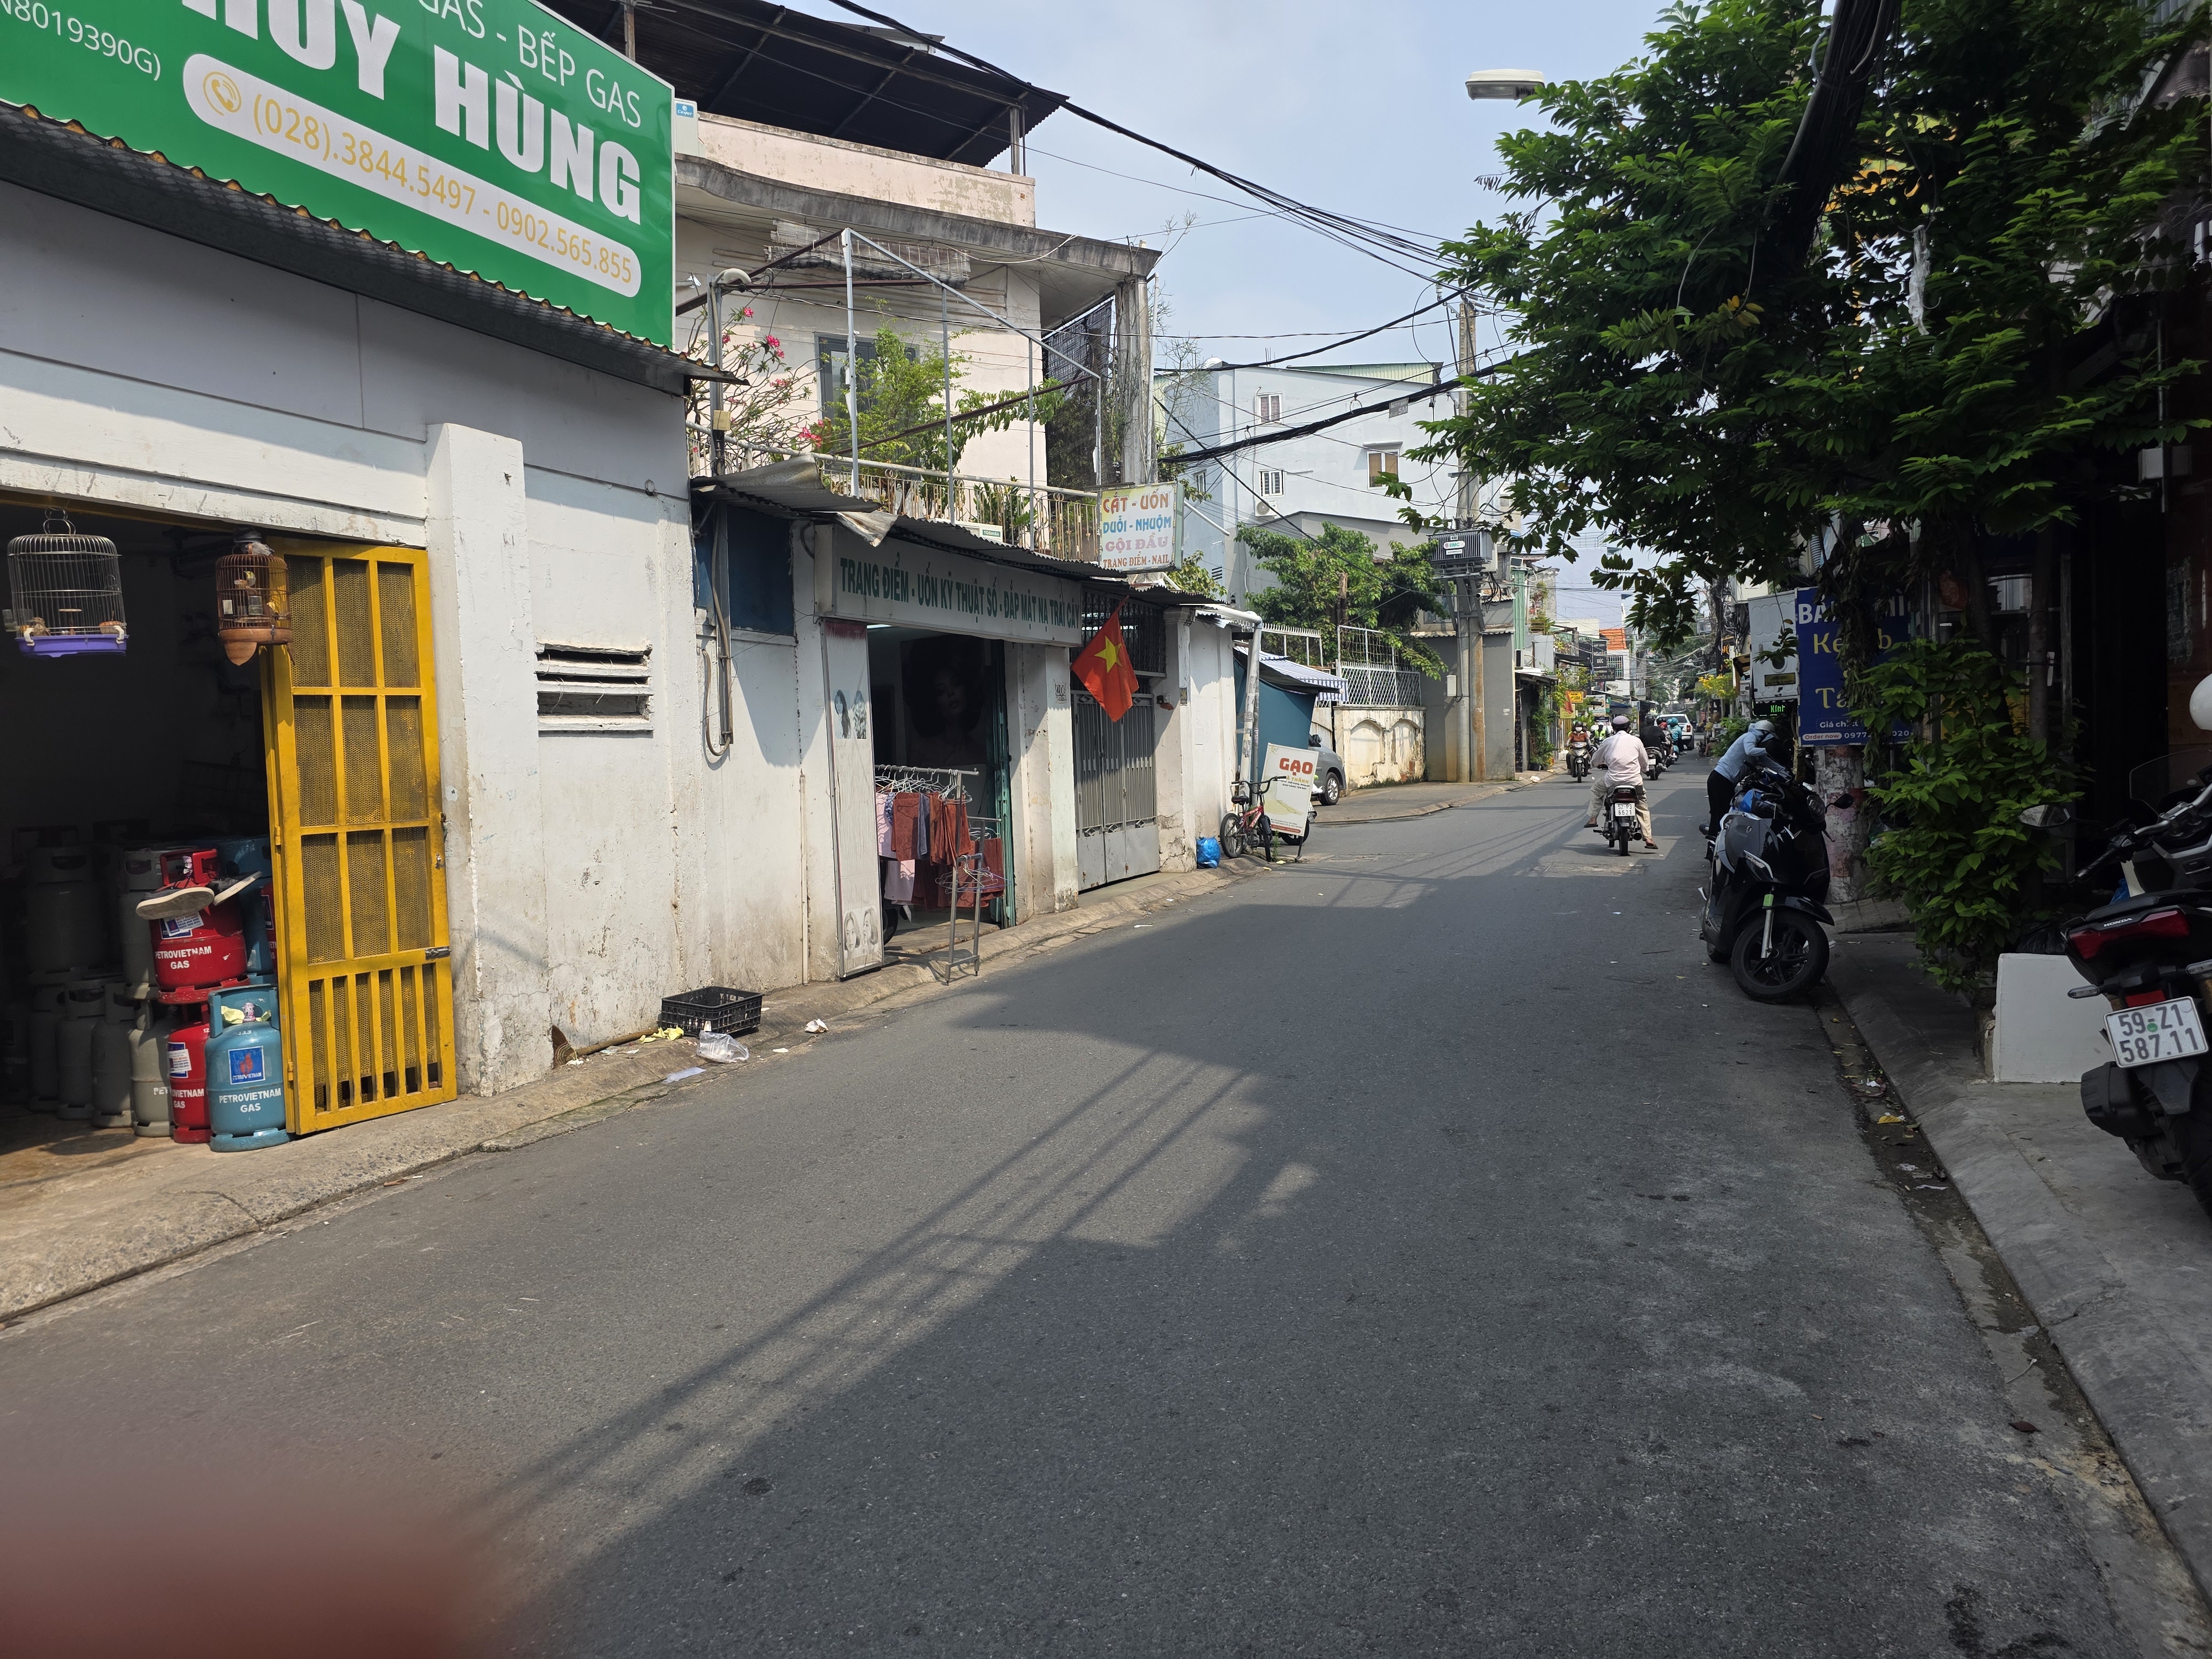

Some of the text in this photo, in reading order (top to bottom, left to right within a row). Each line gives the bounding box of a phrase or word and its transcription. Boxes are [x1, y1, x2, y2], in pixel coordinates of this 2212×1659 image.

[518, 24, 576, 86] BẾP
[586, 69, 641, 128] GAS
[182, 0, 641, 225] UY HÙNG
[254, 93, 476, 215] (028).3844.5497
[497, 201, 632, 284] 0902.565.855
[1399, 406, 1407, 415] 5M
[1103, 491, 1128, 514] CẮT
[1140, 488, 1168, 510] UỐN
[1103, 515, 1126, 534] DUỖI
[1135, 514, 1172, 532] NHUỘM
[1105, 532, 1168, 554] GỘI ĐẦU
[1103, 557, 1127, 568] TRANG
[1129, 551, 1147, 566] ĐIỂM
[1152, 554, 1169, 564] NAIL
[840, 557, 879, 598] TRANG
[883, 552, 909, 603] ĐIỂM
[917, 562, 938, 607] UỐN
[941, 570, 953, 610] KỸ
[956, 578, 984, 623] THUẬT
[987, 577, 997, 618] SỐ
[1004, 580, 1019, 620] ĐẮP
[1021, 588, 1036, 630] MẶT
[1038, 597, 1048, 632] NẠ
[1050, 593, 1065, 627] TRÁI
[1067, 598, 1079, 629] CÂY
[1279, 758, 1313, 776] GẠO
[2104, 917, 2132, 927] HONDA
[155, 946, 212, 959] PETROVIETNAM
[170, 961, 190, 969] GAS
[2118, 1004, 2183, 1036] 59-Z1
[2119, 1027, 2198, 1062] 587.11
[174, 1100, 185, 1109] GAS
[219, 1088, 281, 1104] PETROVIETNAM
[240, 1103, 261, 1113] GAS
